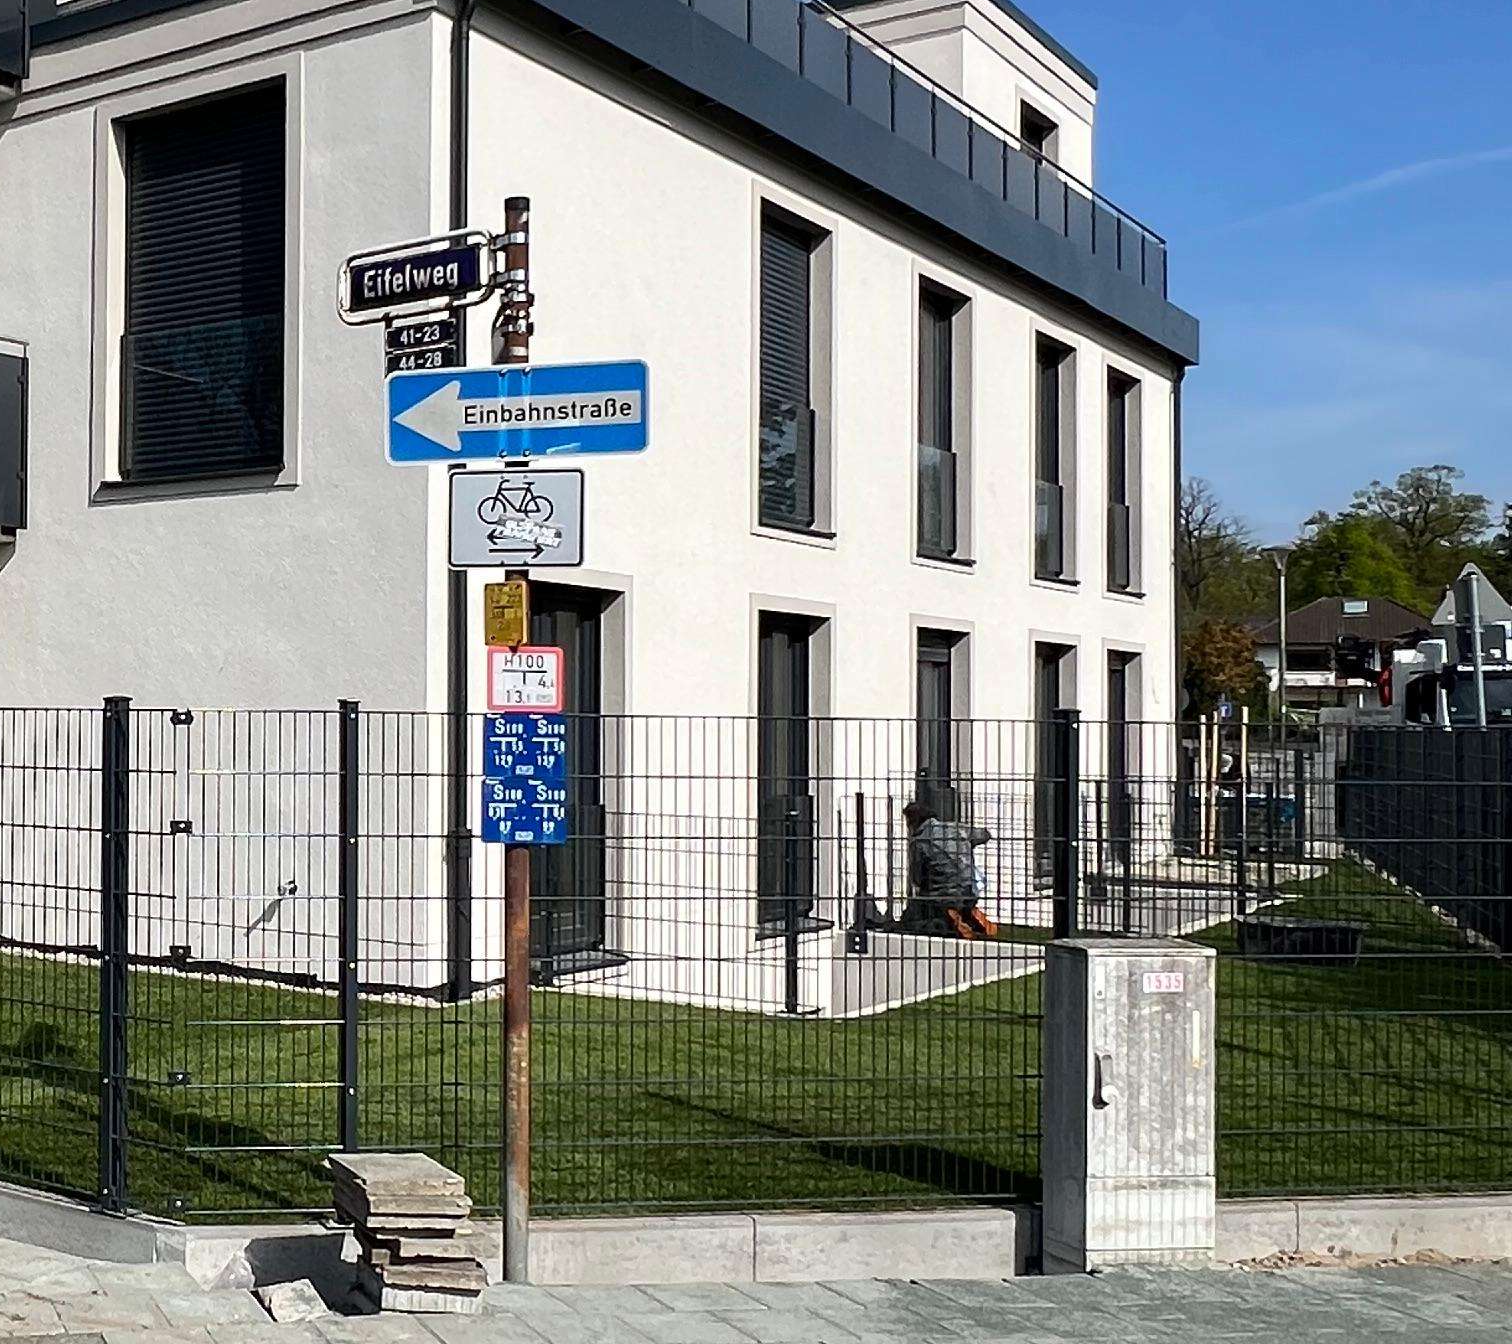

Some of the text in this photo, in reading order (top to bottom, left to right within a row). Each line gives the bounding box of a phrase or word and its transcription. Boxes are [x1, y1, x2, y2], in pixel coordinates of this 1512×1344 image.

[364, 262, 459, 298] Eifelweg
[400, 325, 440, 345] 41-23
[399, 351, 442, 370] 44-28
[464, 398, 632, 424] Einbahnstraße
[1147, 975, 1181, 989] 1535
